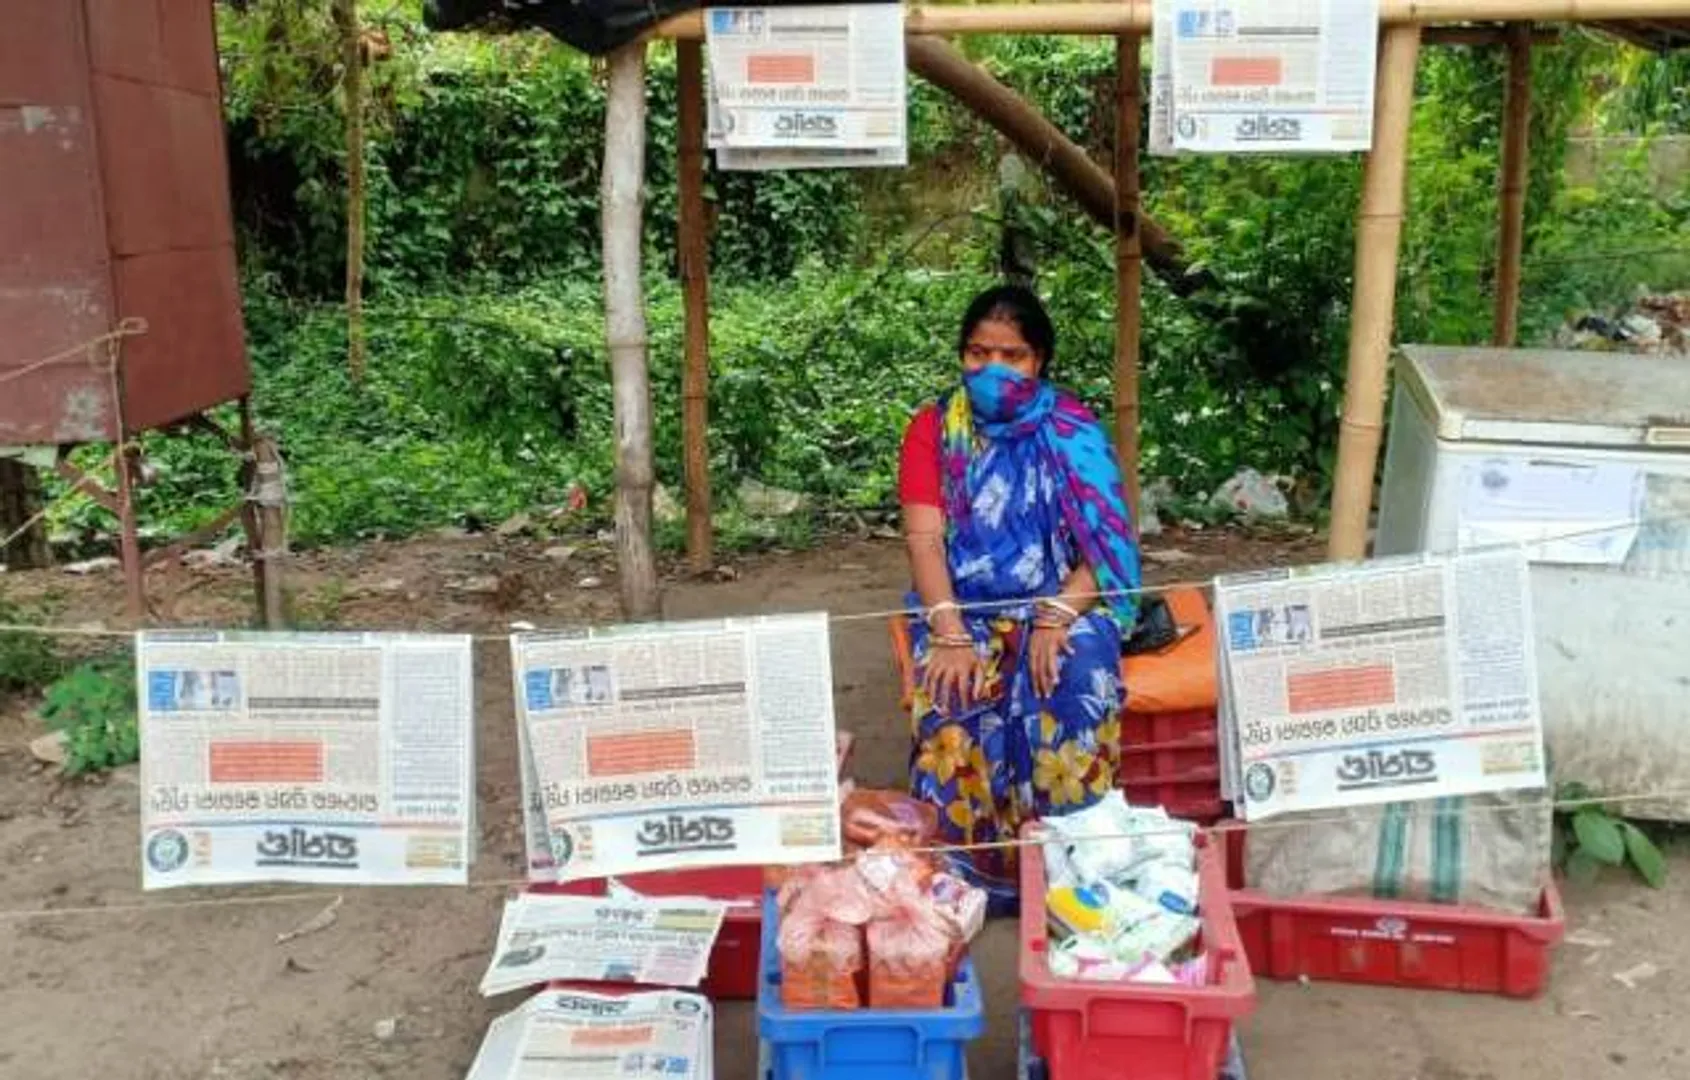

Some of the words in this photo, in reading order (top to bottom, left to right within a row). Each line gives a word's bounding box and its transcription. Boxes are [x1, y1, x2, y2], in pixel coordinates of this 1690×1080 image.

[1336, 751, 1438, 791] ସମ୍ବାଦ
[255, 826, 360, 869] ସମ୍ବାଦ
[636, 814, 737, 856] ସମ୍ବାଦ
